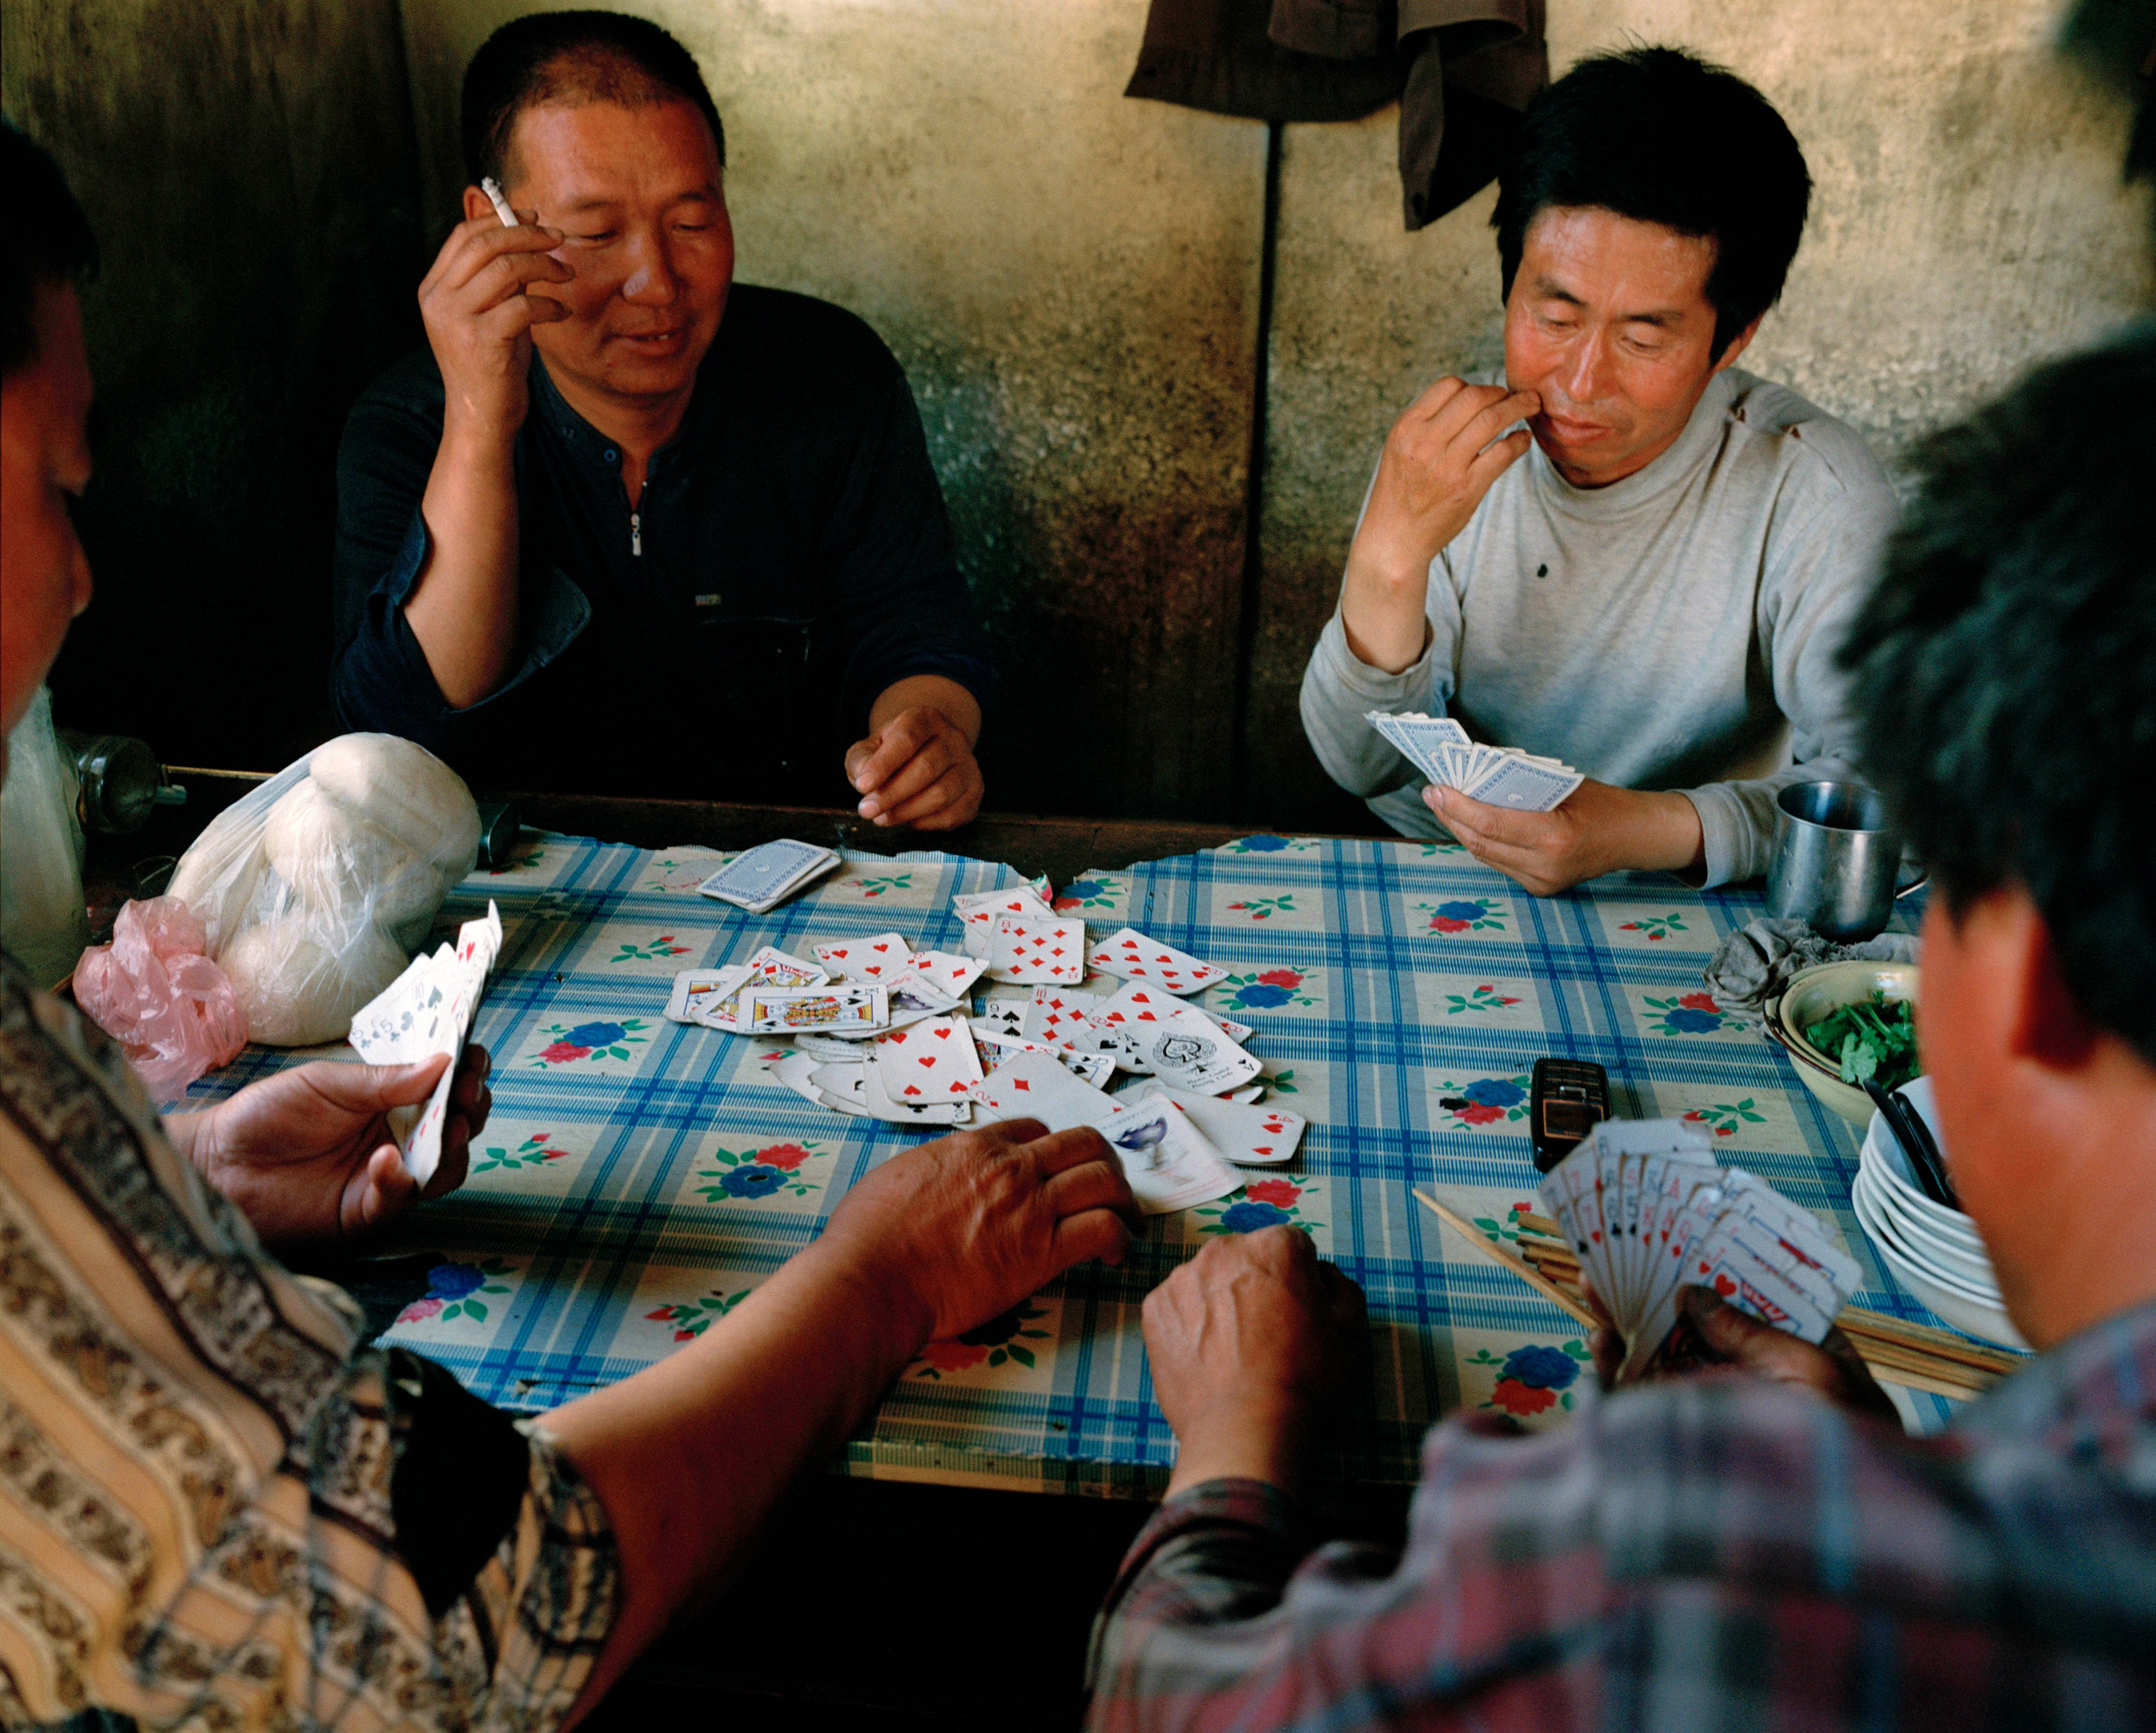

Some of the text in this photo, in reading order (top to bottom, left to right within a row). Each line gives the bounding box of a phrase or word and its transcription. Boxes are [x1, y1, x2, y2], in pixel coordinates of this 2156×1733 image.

[415, 982, 424, 1001] 10
[1036, 988, 1047, 999] 10
[380, 1018, 393, 1033] 5
[976, 1090, 990, 1101] 2
